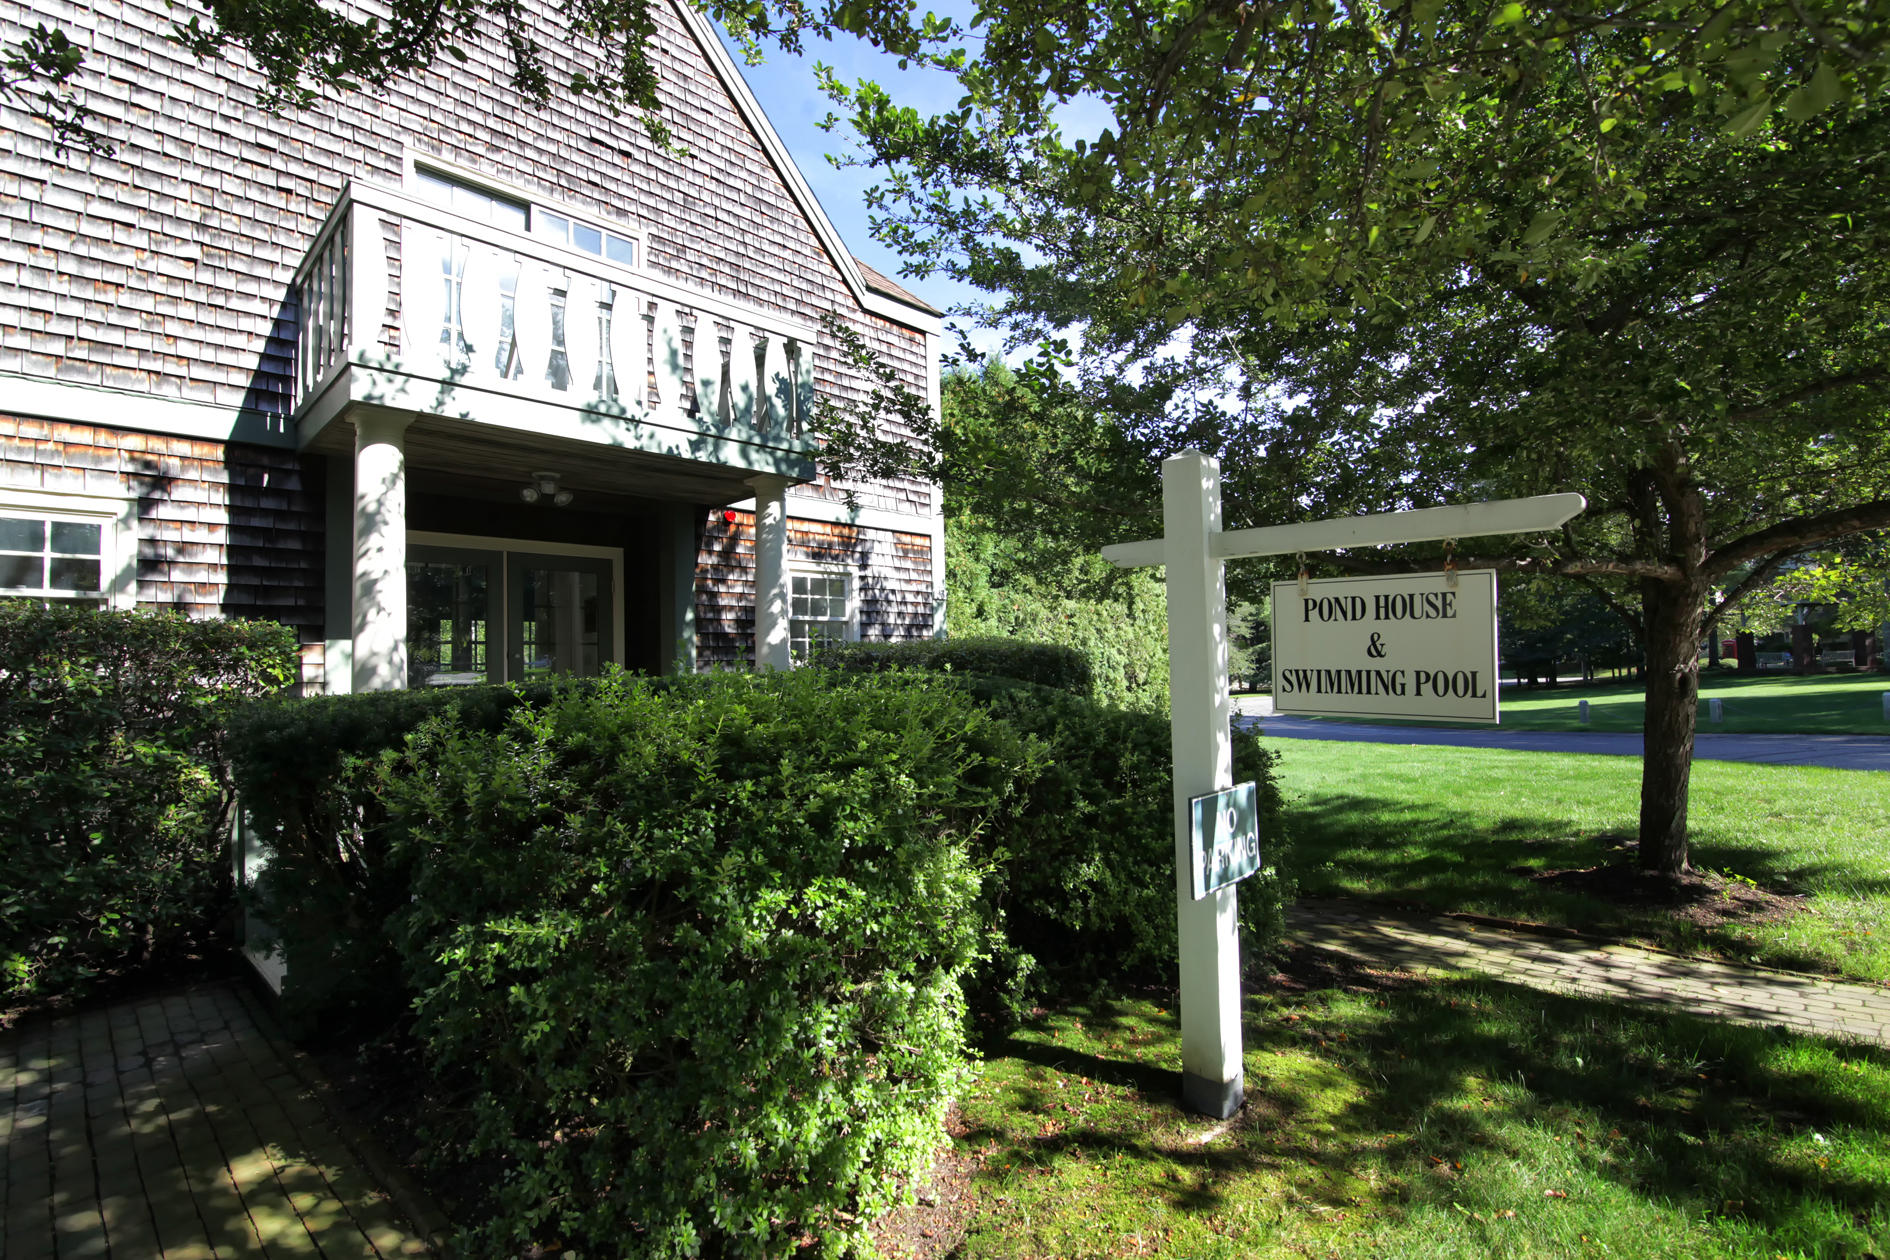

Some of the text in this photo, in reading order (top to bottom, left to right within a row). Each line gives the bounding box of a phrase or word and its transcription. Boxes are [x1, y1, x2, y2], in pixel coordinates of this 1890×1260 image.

[1303, 591, 1457, 623] POND HOUSE
[1366, 632, 1387, 658] &
[1281, 668, 1487, 699] SWIMMING POOL
[1216, 807, 1237, 837] NO
[1199, 831, 1257, 877] PARKING
